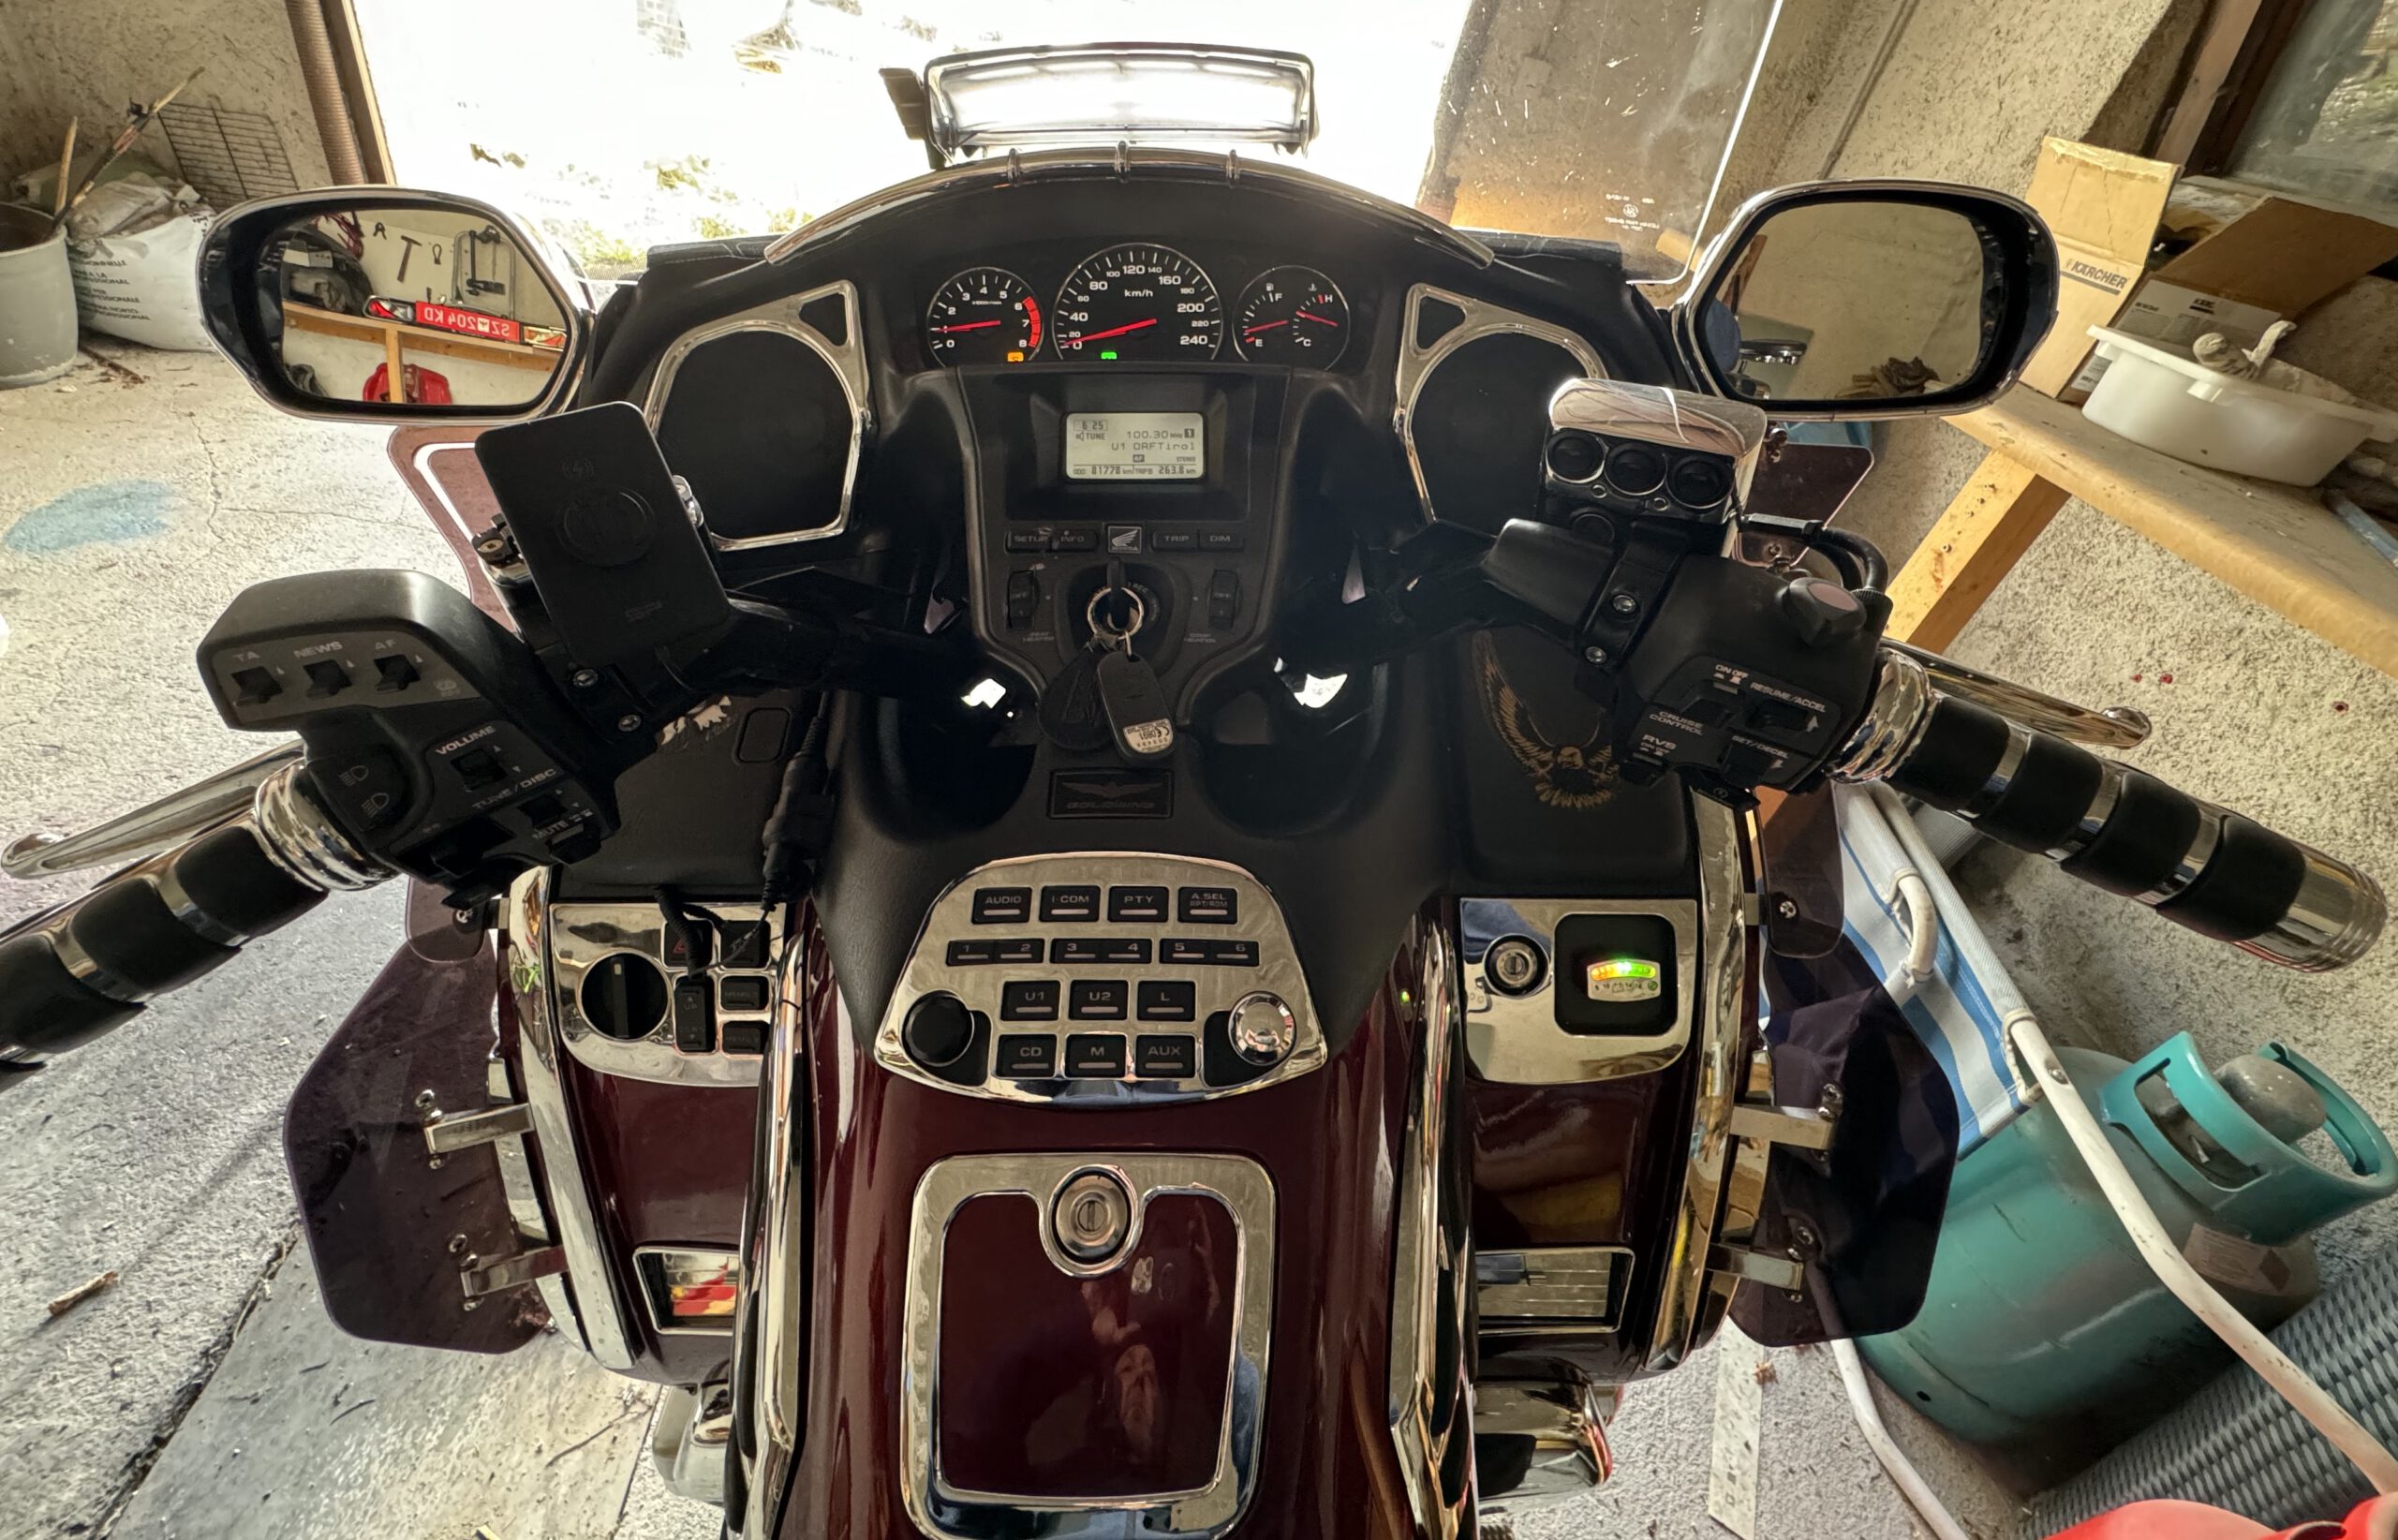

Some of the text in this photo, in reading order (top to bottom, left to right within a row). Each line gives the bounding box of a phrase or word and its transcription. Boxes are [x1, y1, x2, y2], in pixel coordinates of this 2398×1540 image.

[1123, 265, 1146, 274] 120
[1159, 275, 1181, 285] 160
[1089, 281, 1108, 290] 80
[962, 292, 970, 301] 3
[999, 290, 1008, 299] 5
[1124, 289, 1153, 298] km/h
[1275, 293, 1282, 302] F
[1325, 294, 1333, 303] H
[1177, 303, 1205, 313] 200
[1070, 312, 1088, 321] 40
[1022, 319, 1029, 328] 7
[946, 339, 955, 348] 0
[1019, 339, 1028, 348] 8
[1180, 335, 1208, 345] 240
[1073, 340, 1082, 350] 0
[1086, 432, 1106, 440] TUNE
[1127, 430, 1169, 439] 100.30
[1111, 442, 1125, 451] U1
[375, 639, 396, 650] AF
[293, 641, 343, 659] NEWS
[236, 651, 260, 661] TA
[1715, 664, 1732, 674] ON
[1750, 682, 1826, 712] RESUME/ACCEL
[1650, 714, 1703, 735] CONTROL
[1659, 711, 1703, 729] CRUISE
[436, 725, 496, 755] VOLUME
[1642, 734, 1677, 749] RVS
[985, 896, 1022, 905] AUDIO
[1124, 896, 1154, 904] PTY
[964, 944, 970, 953] 1
[1020, 943, 1030, 952] 2
[1128, 942, 1139, 951] 4
[1175, 942, 1185, 951] 5
[1236, 943, 1246, 952] 6
[1025, 991, 1044, 1000] U1
[1089, 991, 1111, 1000] U2
[1161, 992, 1170, 1000] L
[1020, 1046, 1043, 1057] CD
[1090, 1046, 1104, 1056] M
[1147, 1045, 1181, 1056] AUX
